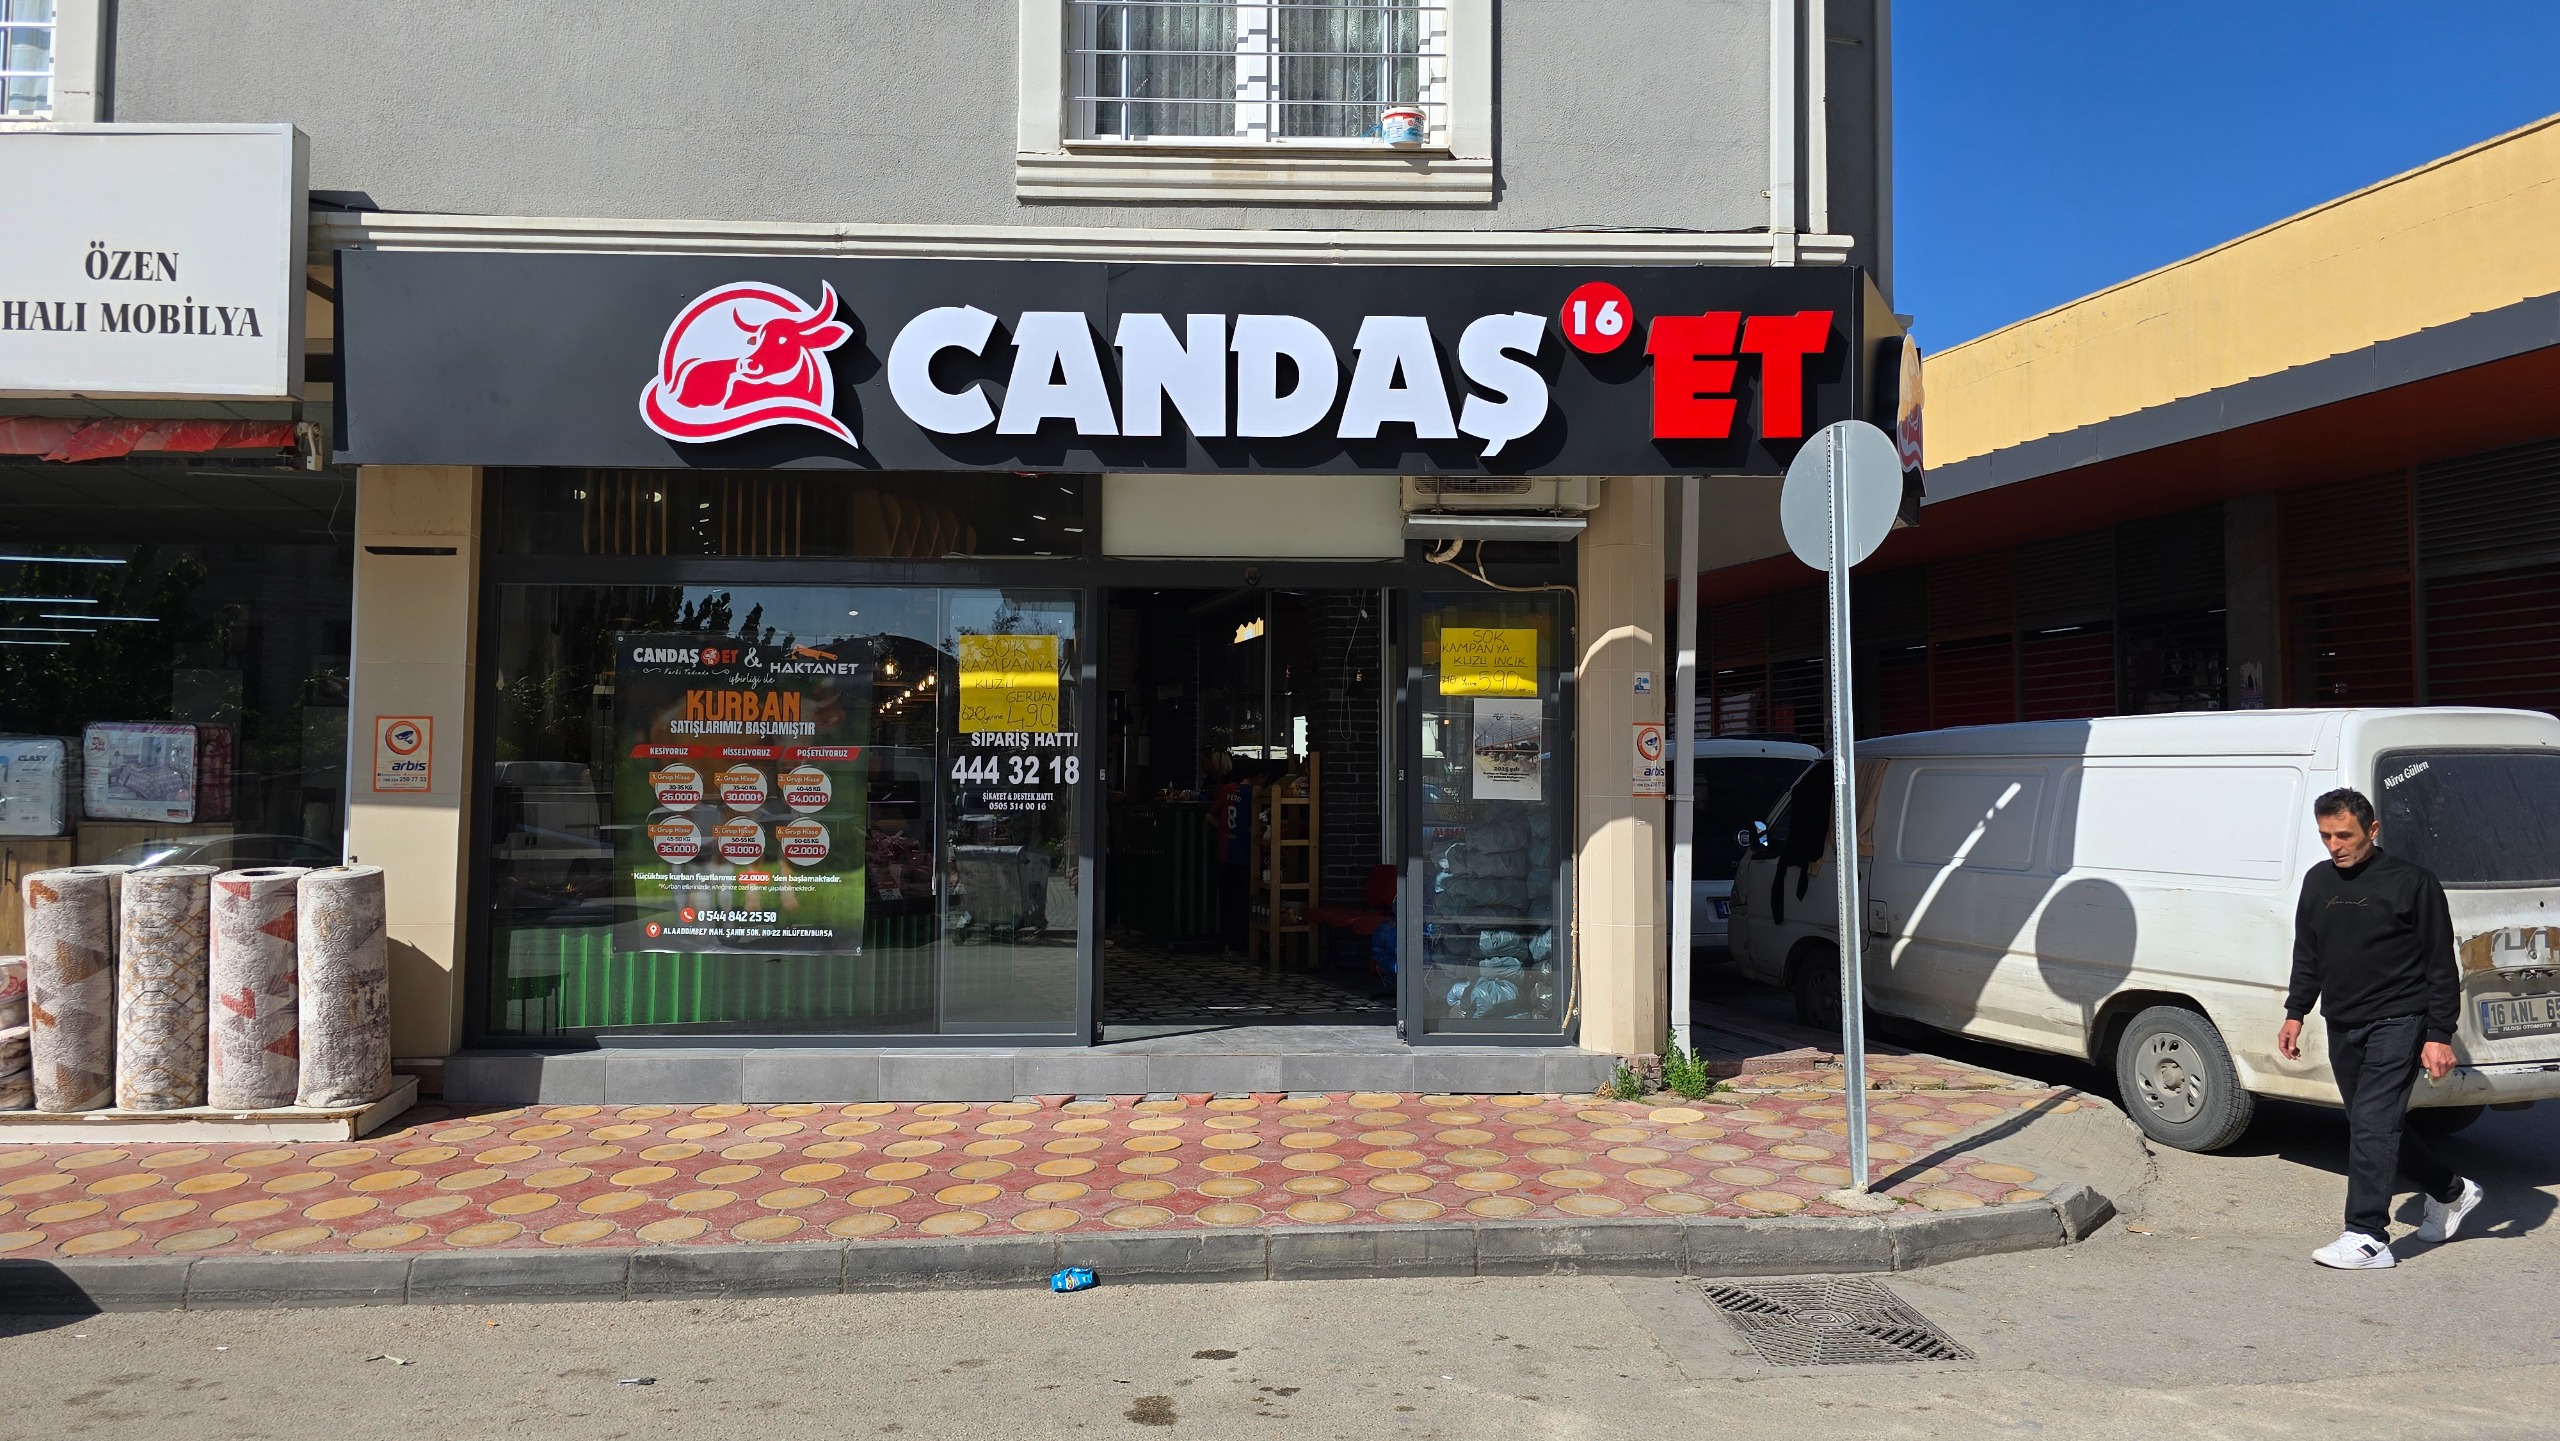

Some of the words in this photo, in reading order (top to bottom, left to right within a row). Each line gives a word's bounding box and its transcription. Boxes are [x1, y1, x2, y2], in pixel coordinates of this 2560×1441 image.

[84, 241, 180, 283] ÖZEN
[1, 300, 87, 334] HALI
[100, 296, 263, 338] MOBİLYA
[1570, 297, 1625, 337] 16
[886, 305, 1548, 457] CANDAŞ
[1645, 310, 1833, 440] ET
[633, 647, 699, 668] CANDAŞ
[721, 649, 739, 664] ET
[743, 647, 763, 668] &
[770, 662, 859, 675] HAKTANET
[961, 658, 1055, 673] KAMPANYA
[1453, 655, 1487, 666] KUZU
[975, 678, 1014, 690] KUZU
[686, 690, 801, 721] KURBAN
[1006, 690, 1057, 703] GERDAN
[1006, 703, 1054, 729] 490
[670, 720, 743, 739] SATIŞLARIMIZ
[745, 721, 816, 739] BAŞLAMIŞTIR
[971, 729, 1030, 751] SİPARİŞ
[1034, 732, 1079, 747] HATTI
[649, 746, 688, 755] KESİYORUZ
[722, 747, 771, 757] HİSSELİYORUZ
[797, 748, 848, 758] POŞETLİYORUZ
[392, 761, 426, 771] arbis
[951, 755, 1000, 785] 444
[1008, 755, 1040, 785] 32
[1049, 755, 1080, 785] 18
[2383, 772, 2405, 790] Mira
[2403, 760, 2429, 782] Gülten
[1013, 793, 1035, 801] DESTEK
[1227, 805, 1237, 829] 8
[669, 873, 694, 881] kurban
[706, 911, 727, 922] 544
[728, 911, 747, 922] 842
[2490, 1003, 2505, 1026] 16
[2511, 1001, 2539, 1024] ANL
